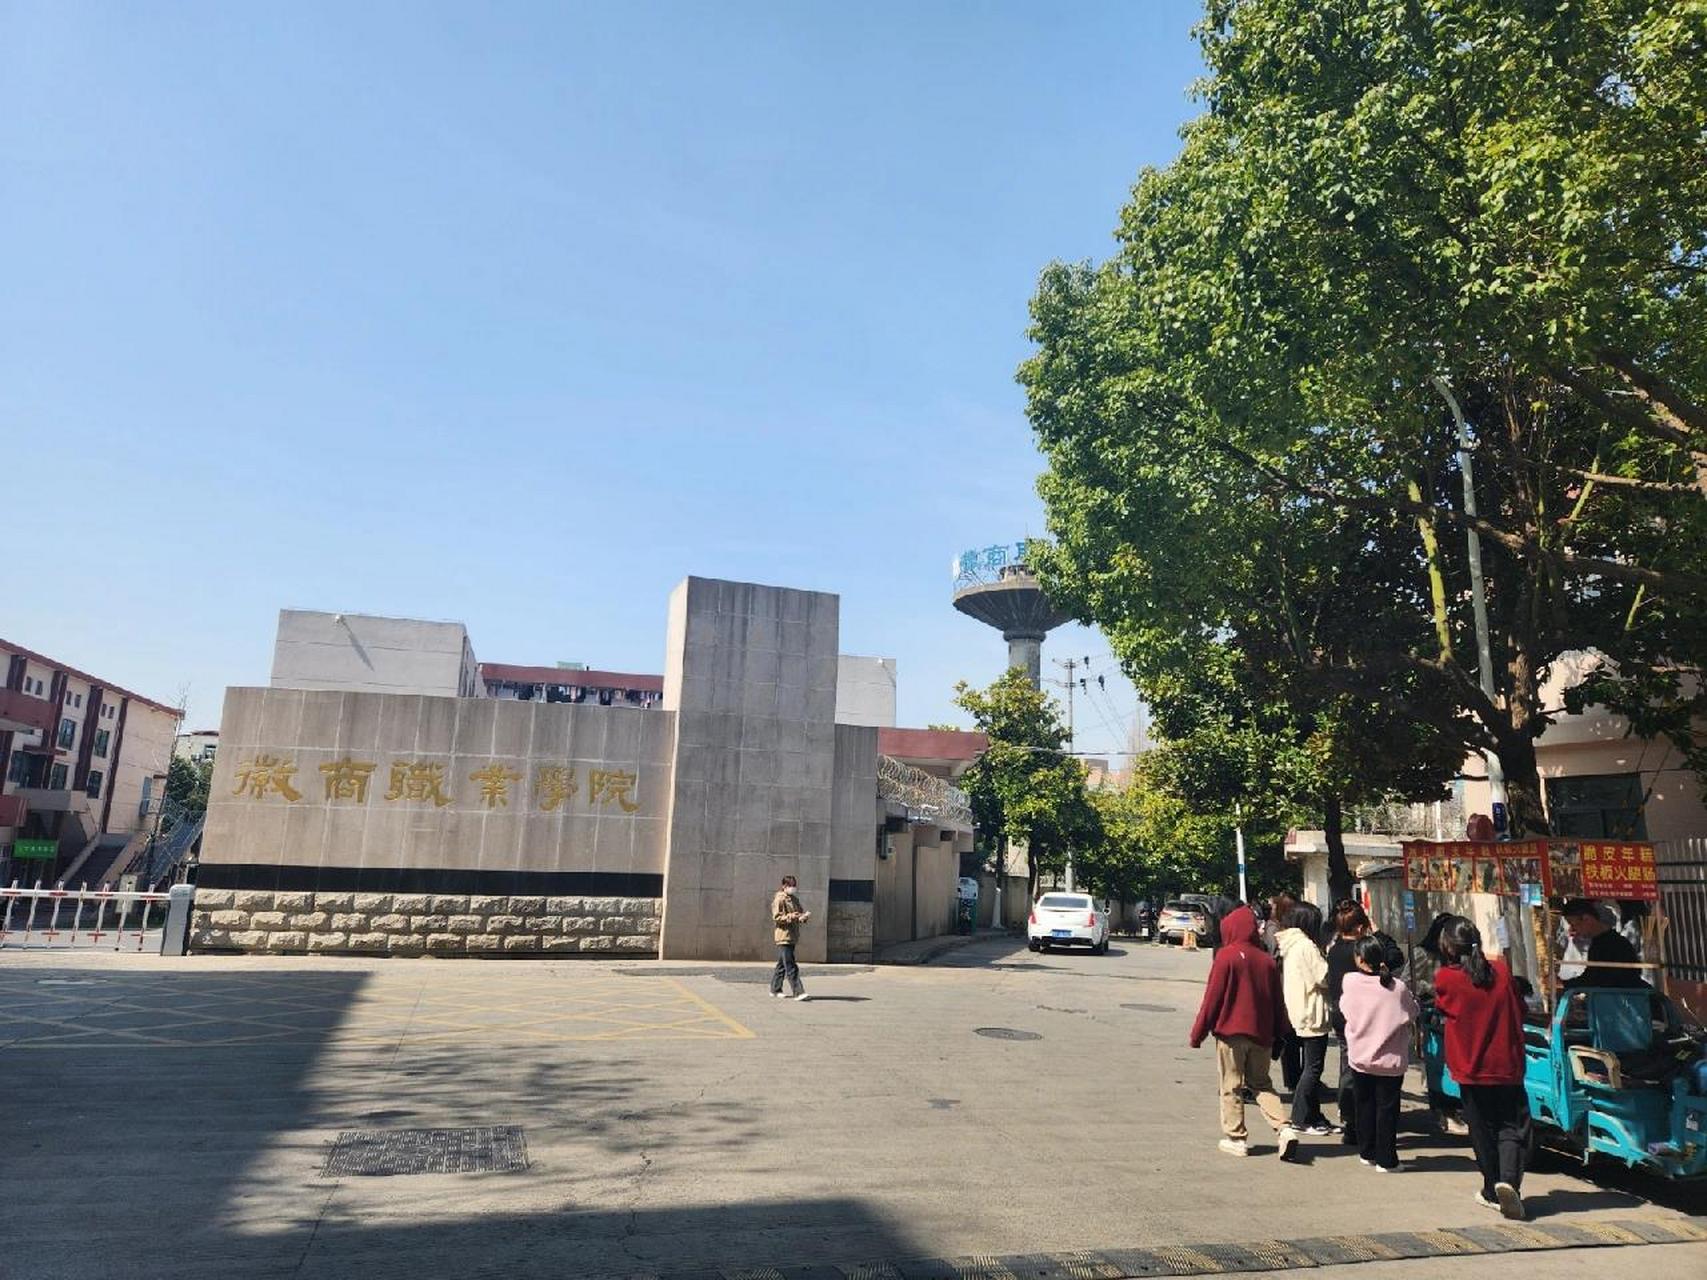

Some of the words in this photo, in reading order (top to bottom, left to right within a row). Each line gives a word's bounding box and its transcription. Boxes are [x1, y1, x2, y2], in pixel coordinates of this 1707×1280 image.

[1585, 864, 1656, 880] 铁板火腿肠
